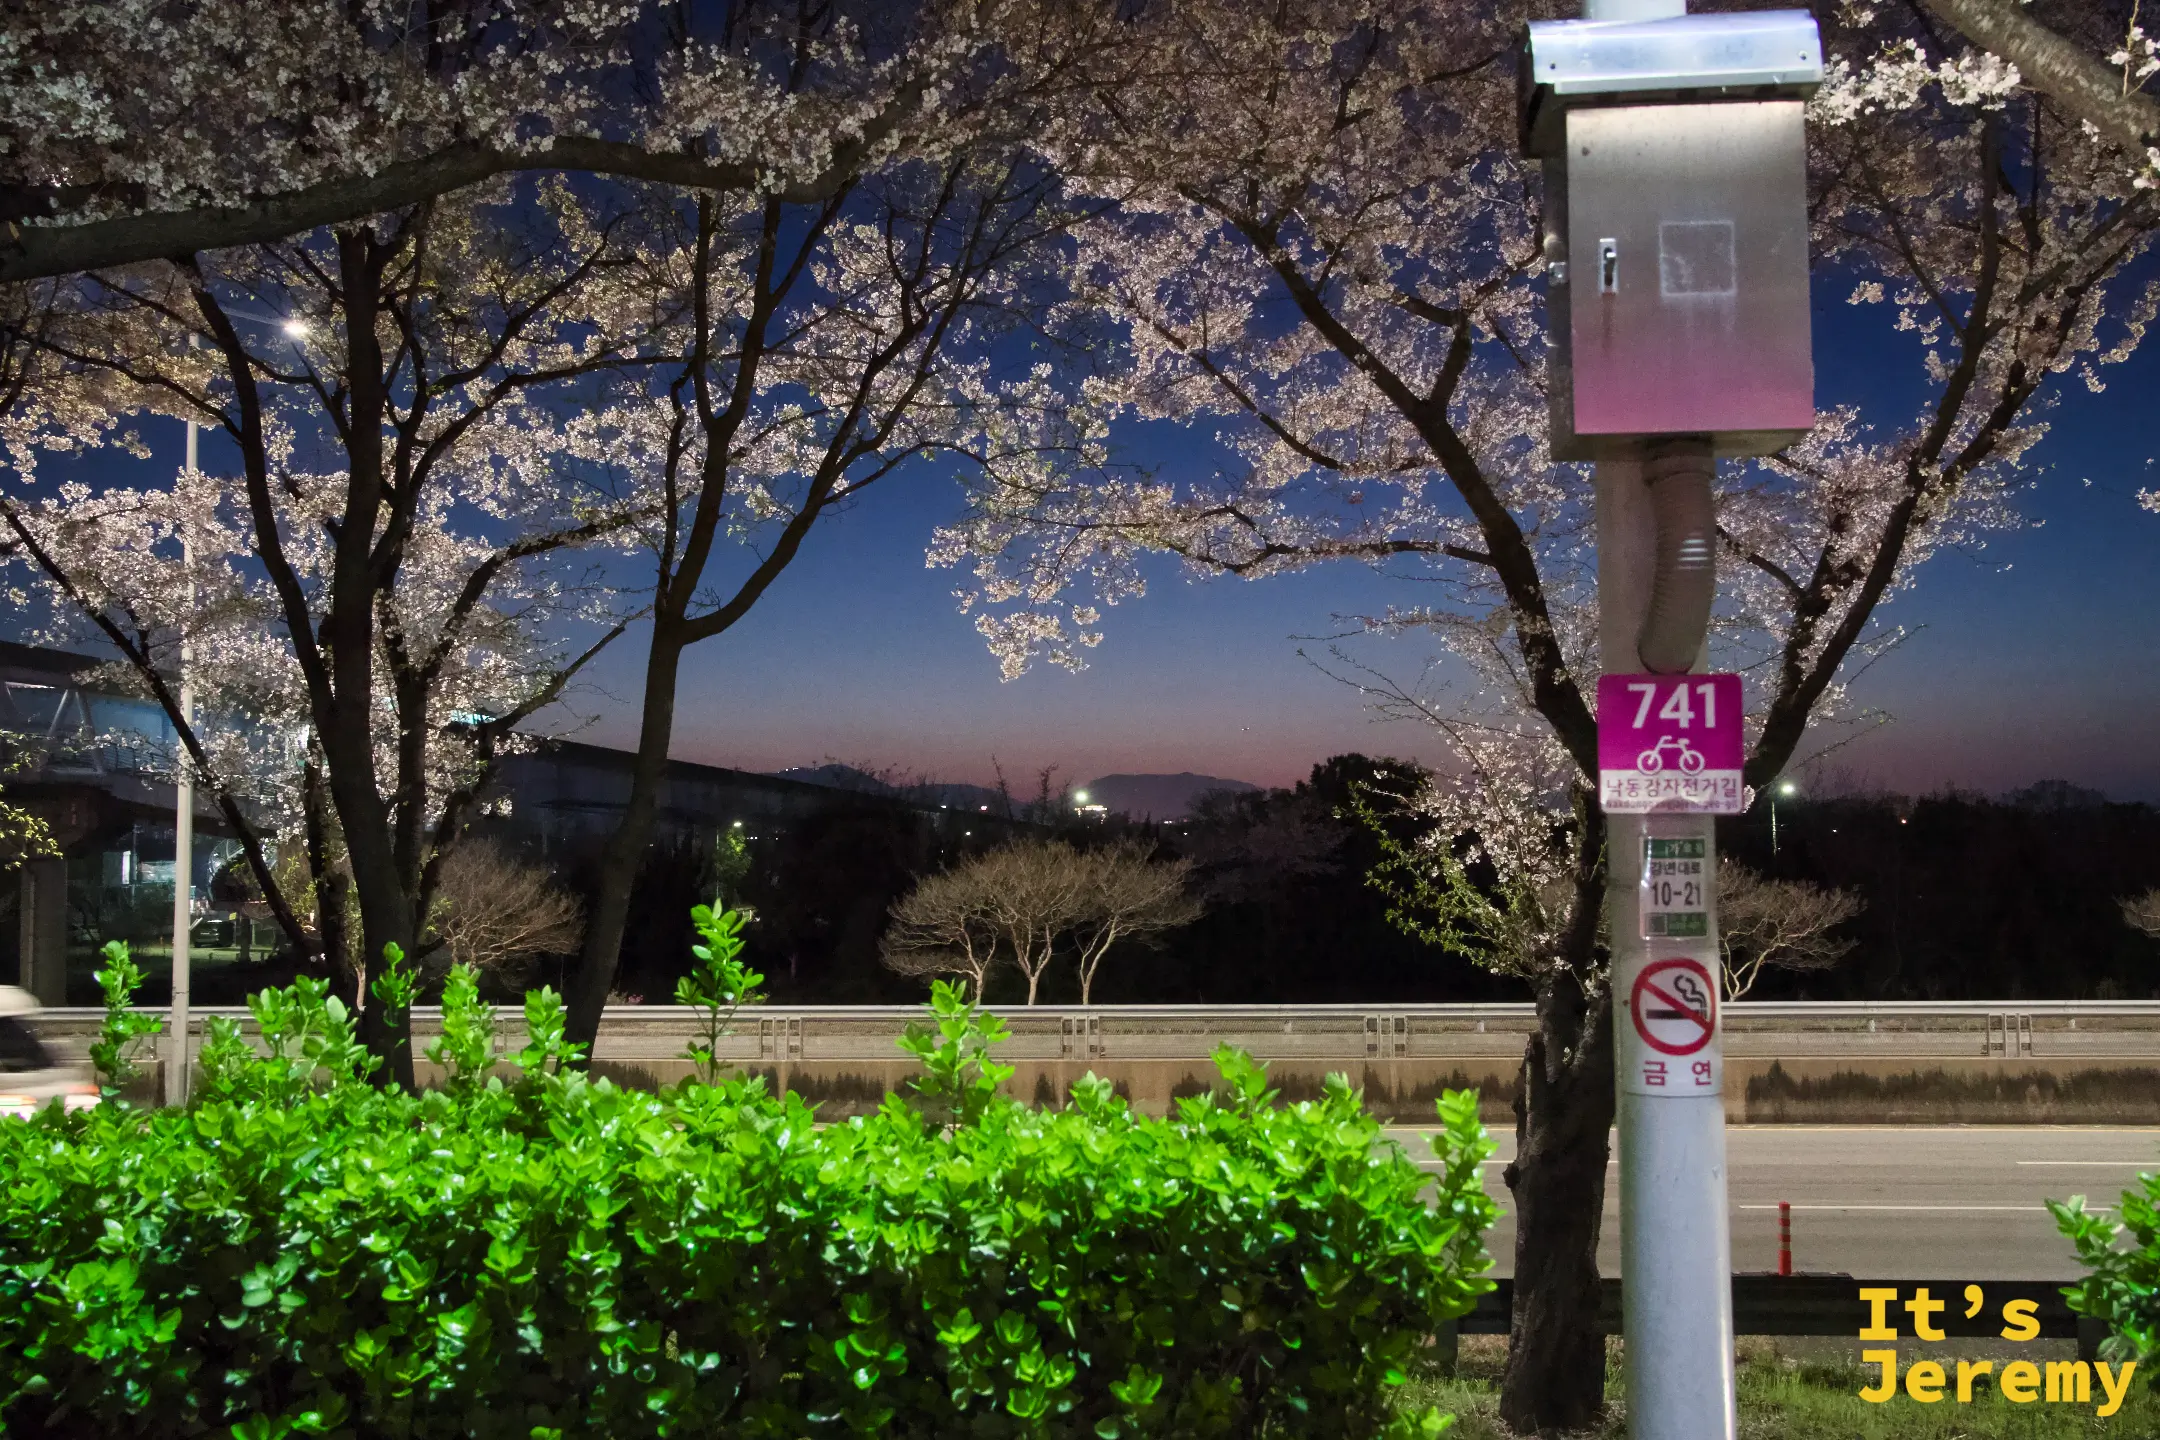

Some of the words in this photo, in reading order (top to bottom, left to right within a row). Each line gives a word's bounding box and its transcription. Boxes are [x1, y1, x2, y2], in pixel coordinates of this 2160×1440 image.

[1627, 683, 1717, 729] 741
[1606, 778, 1737, 798] 낙동강자전거길
[1651, 881, 1701, 907] 10-21
